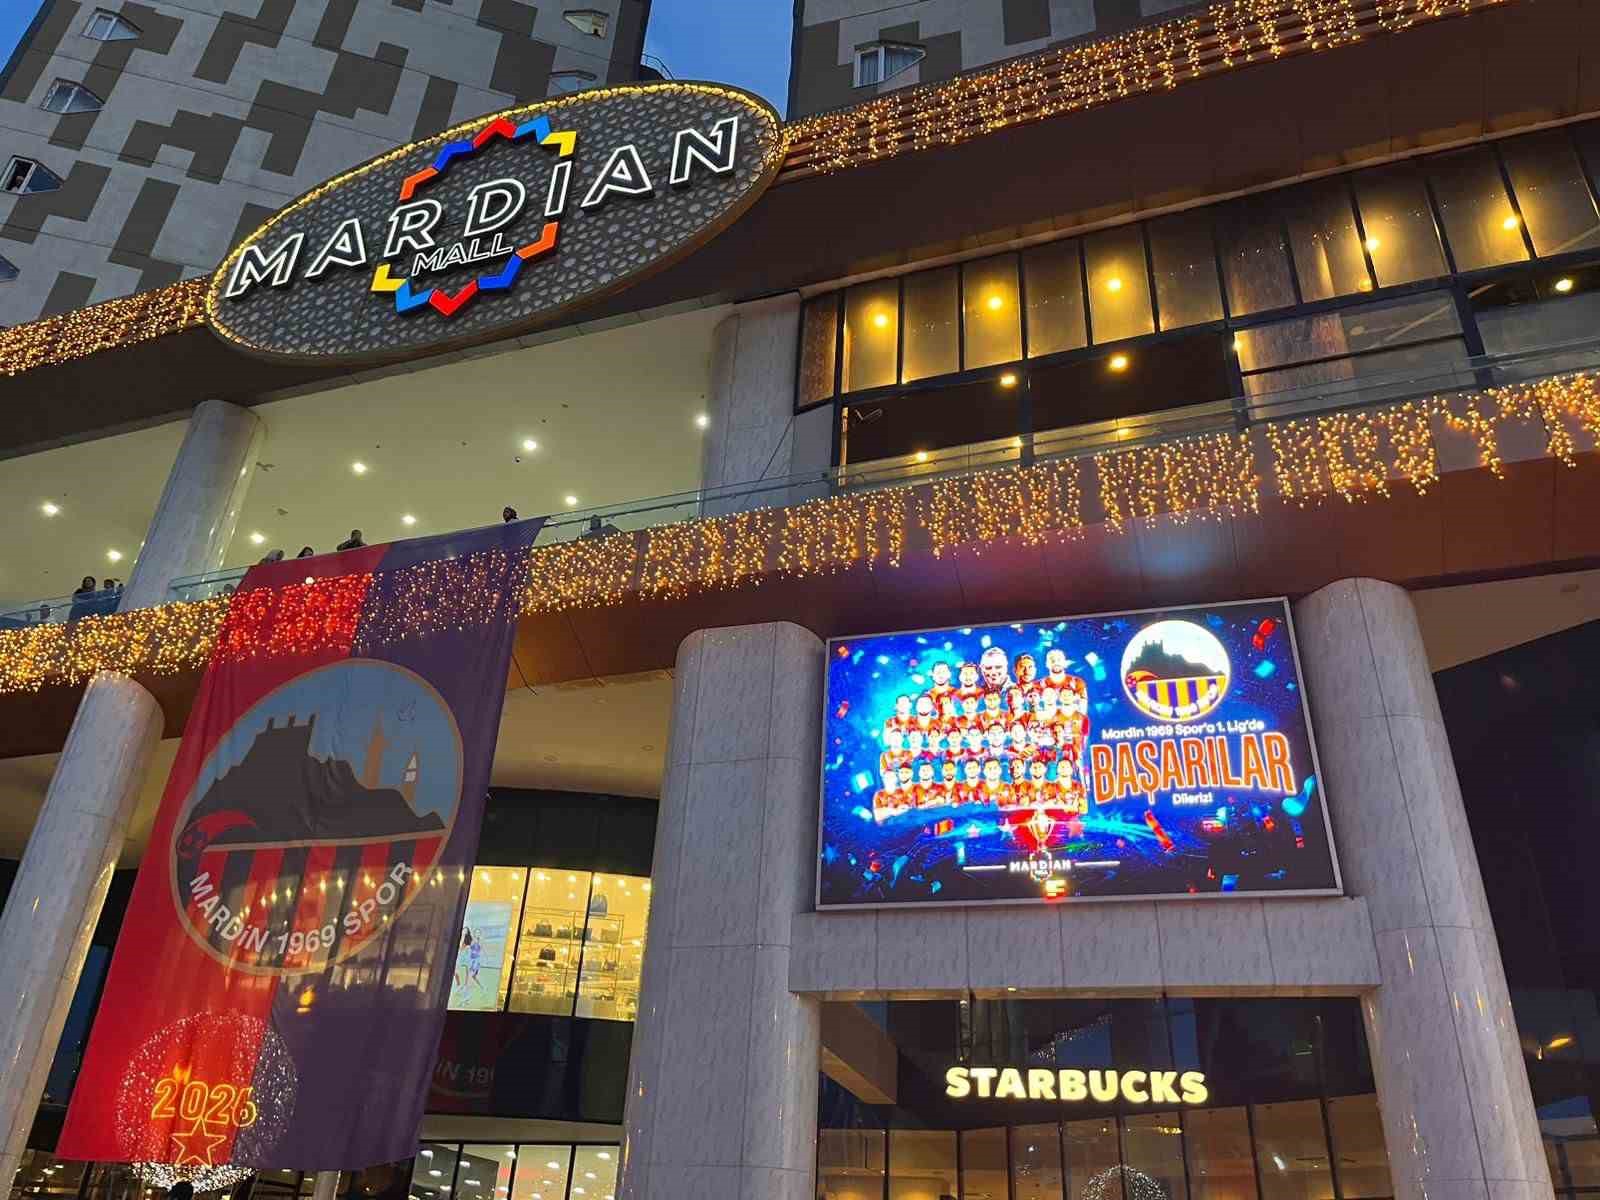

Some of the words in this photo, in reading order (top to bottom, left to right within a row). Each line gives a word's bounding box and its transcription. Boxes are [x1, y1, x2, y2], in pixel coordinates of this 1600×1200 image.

[225, 116, 738, 297] MARDIAN
[411, 232, 513, 277] MALL
[1102, 726, 1144, 740] Mardin
[1145, 724, 1173, 737] 1969
[1091, 732, 1296, 805] BAŞARILAR
[277, 925, 335, 954] 1969
[344, 862, 413, 935] SPOR
[151, 1078, 257, 1127] 2026
[945, 1066, 1208, 1104] STARBUCKS
